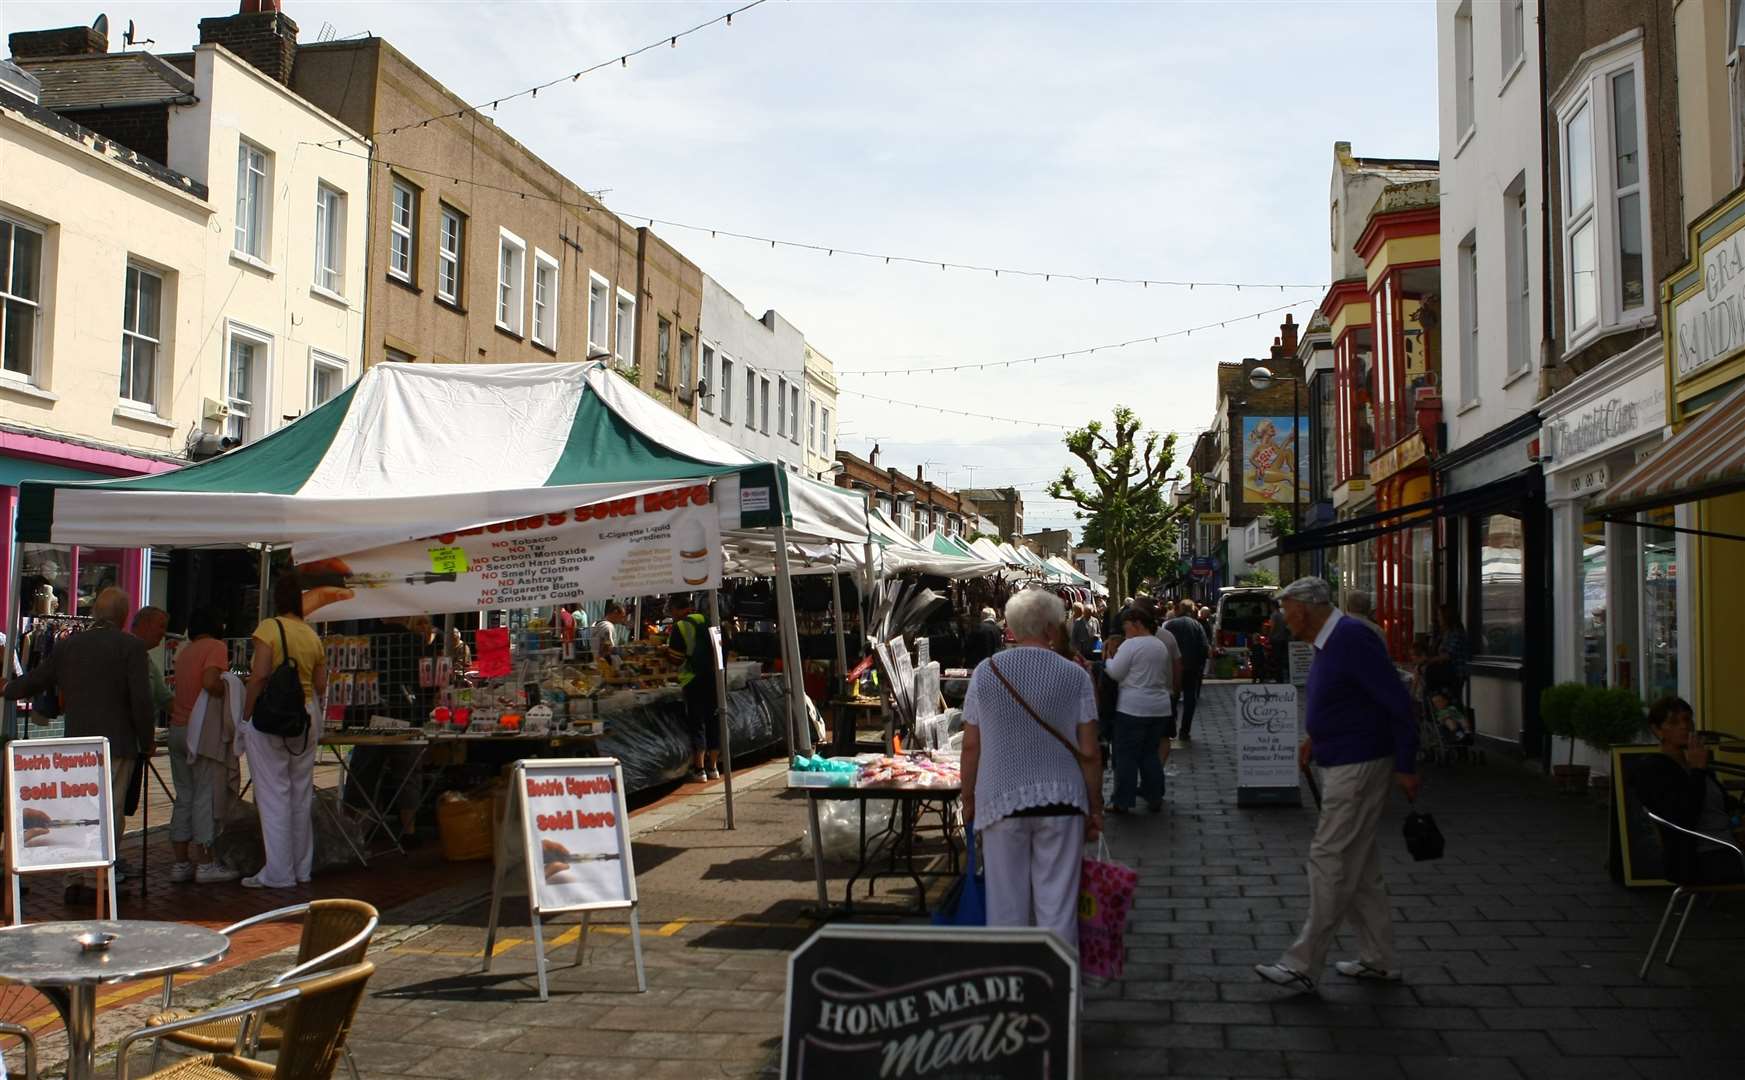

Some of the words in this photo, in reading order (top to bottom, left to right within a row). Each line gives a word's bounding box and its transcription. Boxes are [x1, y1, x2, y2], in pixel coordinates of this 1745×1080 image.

[491, 540, 509, 549] NO
[511, 535, 558, 547] Tobacco
[509, 546, 526, 554] NO
[529, 544, 545, 552] Tar
[466, 565, 482, 573] NO
[486, 560, 526, 571] Second
[529, 558, 557, 567] Hand
[560, 555, 595, 565] Smoke
[472, 557, 489, 565] NO
[492, 553, 531, 563] Carbon
[534, 547, 587, 558] Monoxide
[481, 572, 498, 580] NO
[501, 569, 537, 578] Smelly
[540, 565, 580, 575] Clothes
[498, 579, 515, 587] NO
[518, 575, 564, 586] Ashtrays
[477, 597, 494, 605] NO
[497, 593, 546, 603] Smoker's
[550, 588, 584, 599] Cough
[481, 589, 498, 597] NO
[501, 585, 550, 596] Cigarette
[553, 581, 579, 590] Butts
[20, 782, 57, 801] sold
[61, 781, 98, 798] here
[536, 810, 574, 832] sold
[576, 810, 616, 829] here
[816, 995, 919, 1036] HOME
[924, 975, 1025, 1018] MADE
